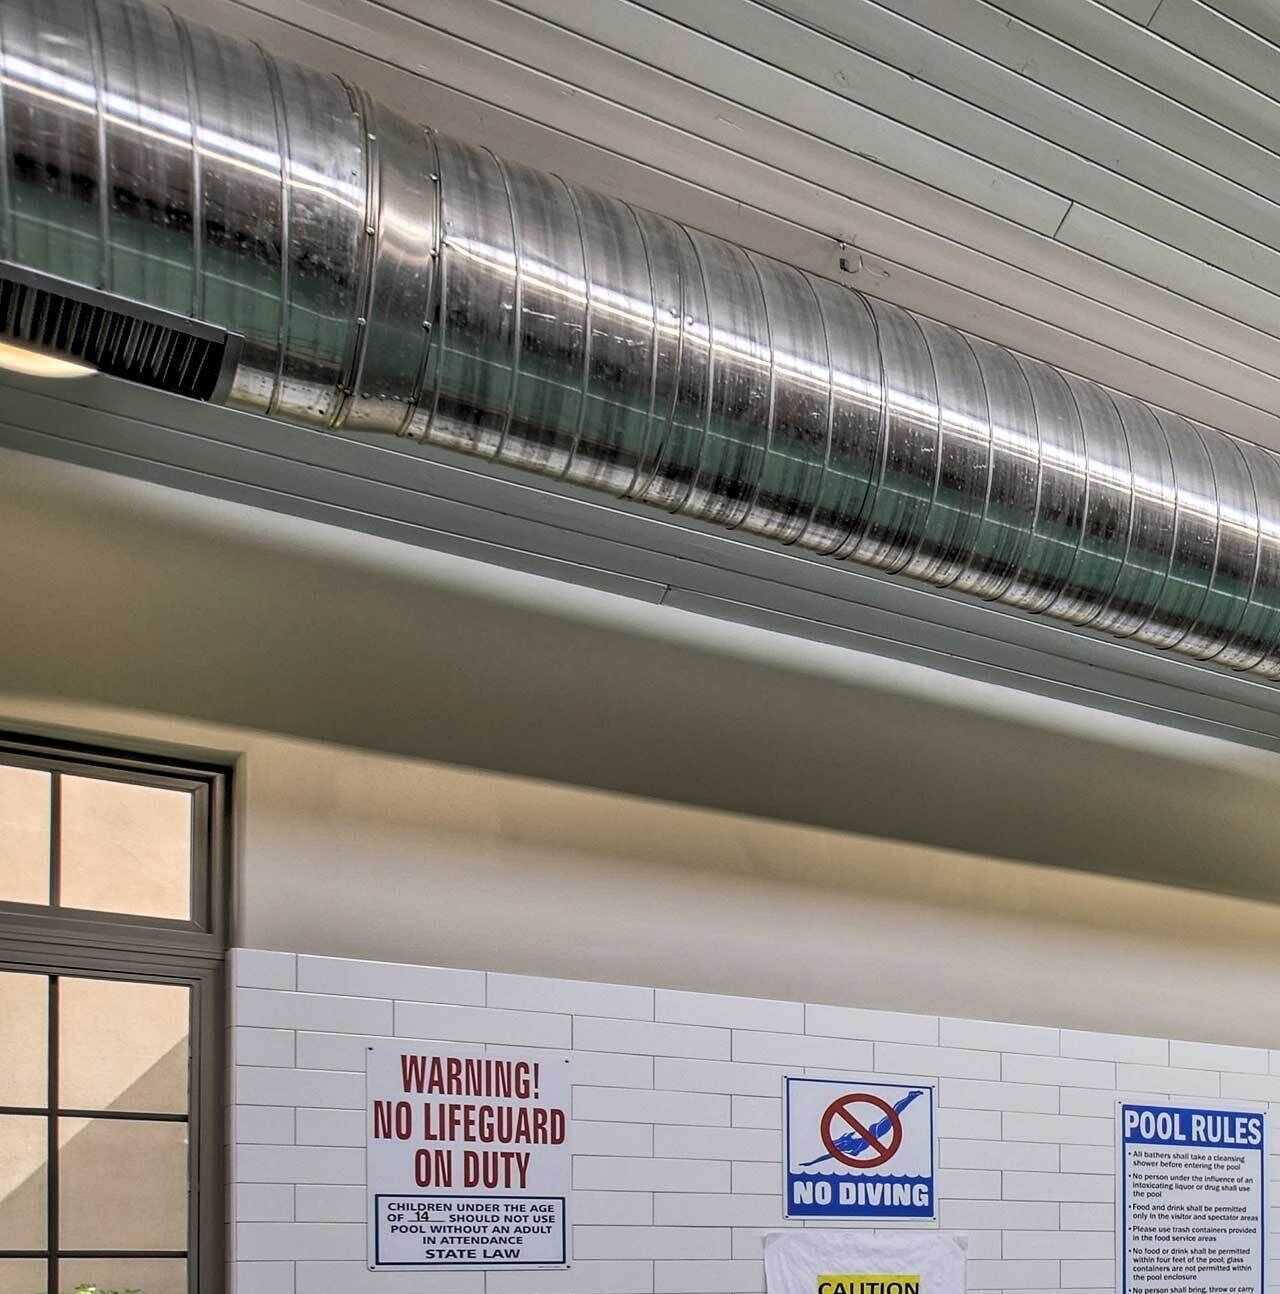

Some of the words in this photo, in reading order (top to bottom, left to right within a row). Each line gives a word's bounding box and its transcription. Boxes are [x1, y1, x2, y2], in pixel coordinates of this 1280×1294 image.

[401, 1055, 539, 1099] WARNING!
[374, 1100, 412, 1140] NO
[424, 1103, 566, 1145] LIFEGUARD
[1124, 1110, 1186, 1141] POOL
[1191, 1114, 1262, 1145] RULES
[415, 1149, 452, 1188] ON
[464, 1150, 530, 1188] DUTY
[793, 1181, 832, 1205] NO
[839, 1182, 929, 1207] DIVING
[1133, 1182, 1173, 1190] intoxicating
[387, 1214, 404, 1222] OF
[414, 1211, 430, 1222] 14
[504, 1215, 529, 1223] NOT
[533, 1215, 555, 1223] USE
[388, 1203, 452, 1211] CHILDREN
[457, 1204, 499, 1212] UNDER
[504, 1204, 526, 1212] THE
[391, 1225, 426, 1233] POOL
[426, 1250, 476, 1258] STATE
[483, 1250, 520, 1258] LAW
